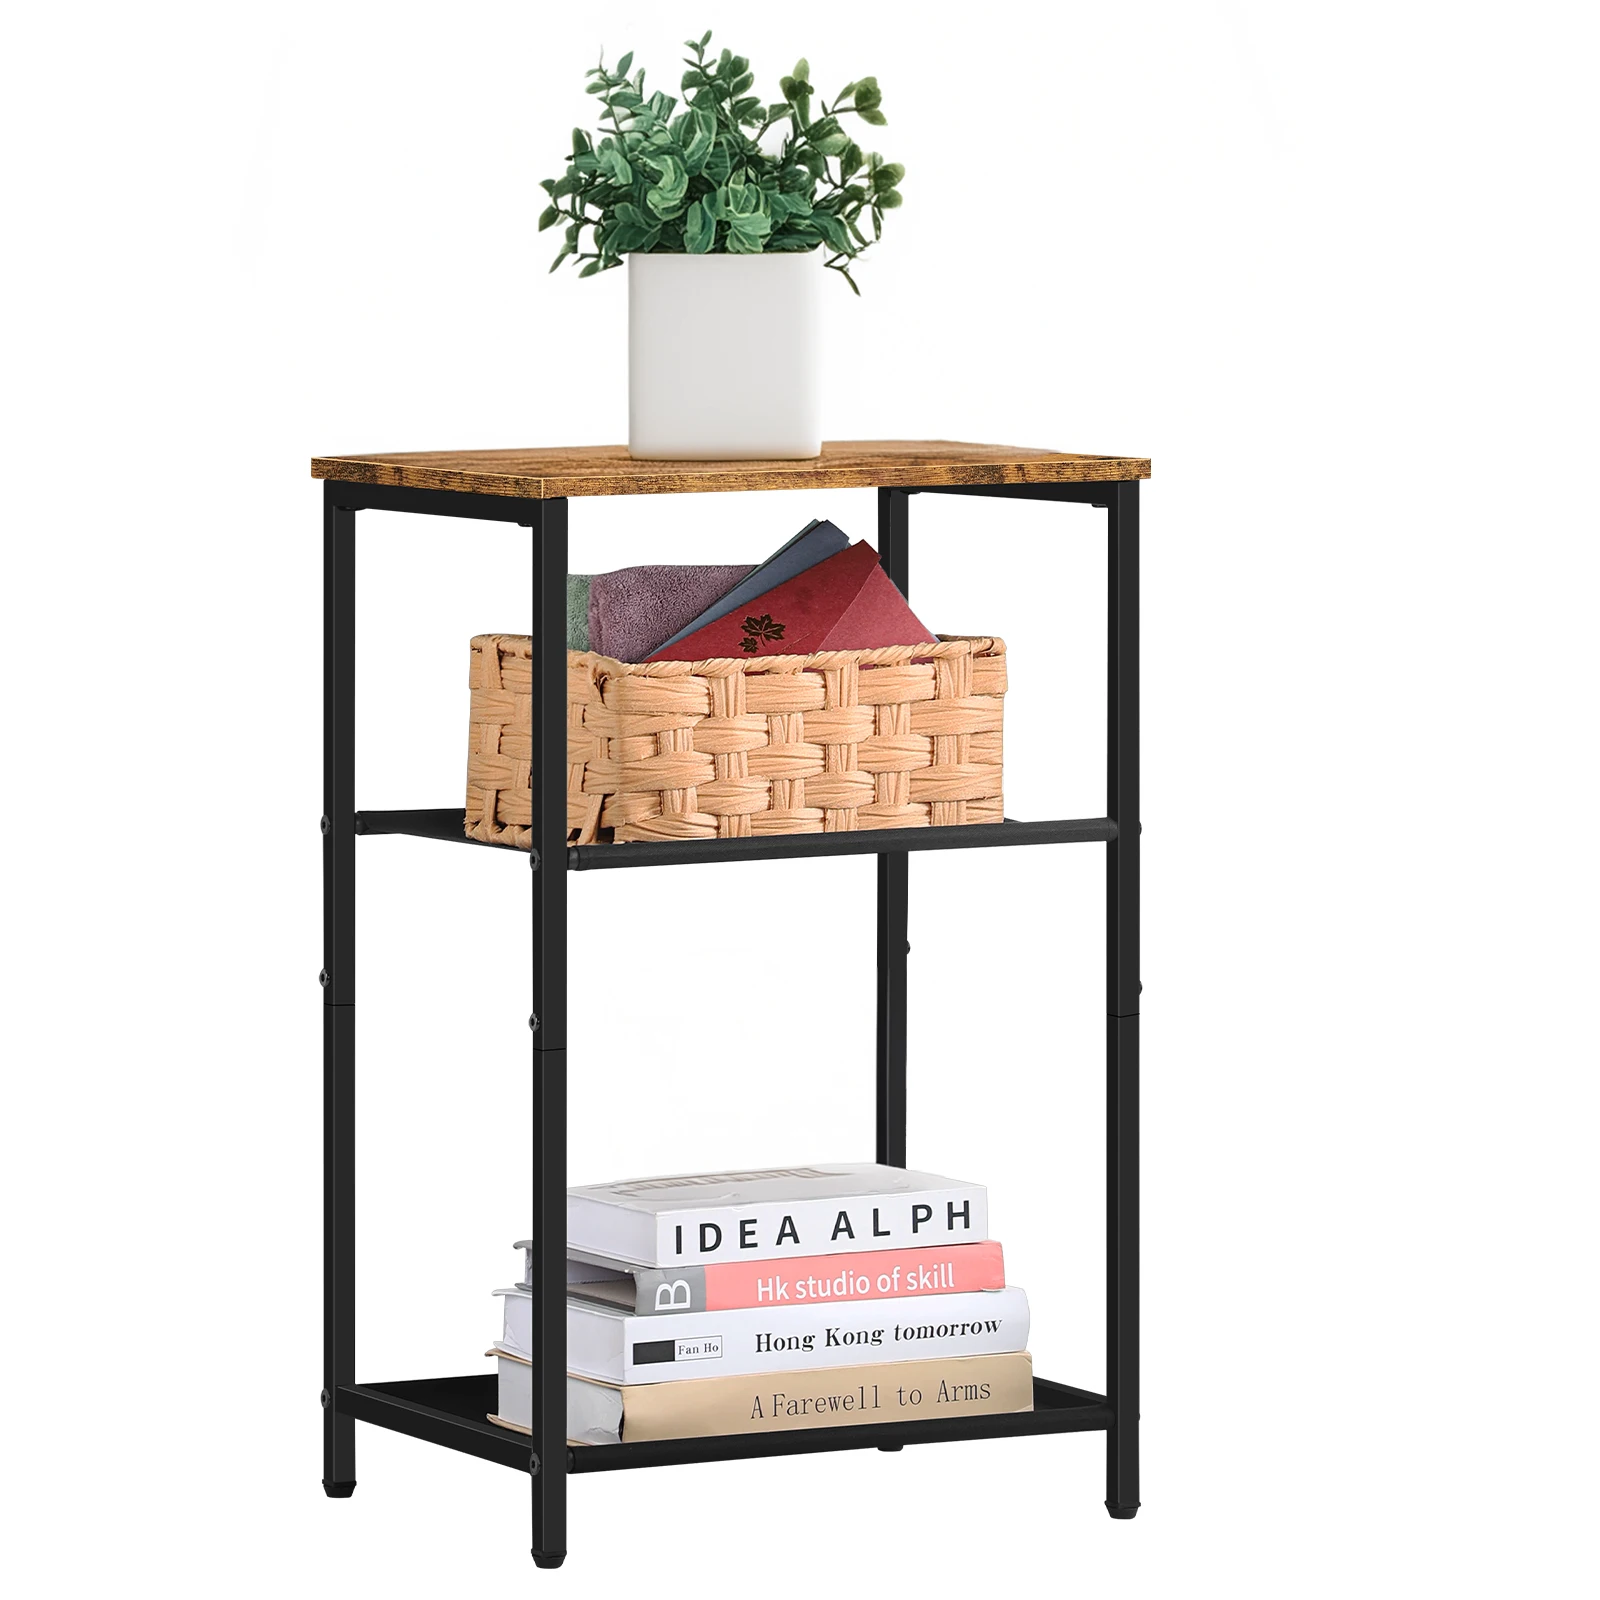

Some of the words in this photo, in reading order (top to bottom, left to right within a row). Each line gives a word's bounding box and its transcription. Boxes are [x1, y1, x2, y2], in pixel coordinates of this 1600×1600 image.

[676, 1215, 800, 1255] IDEA
[830, 1200, 971, 1241] ALPH
[655, 1279, 691, 1310] B
[757, 1276, 790, 1302] Hk
[795, 1270, 872, 1299] studio
[876, 1266, 901, 1293] of
[907, 1262, 955, 1290] skill
[678, 1345, 699, 1356] Fan
[704, 1342, 719, 1353] Ho
[755, 1333, 816, 1353] Hong
[825, 1327, 885, 1347] Kong
[895, 1319, 1002, 1342] tomorrow
[751, 1395, 764, 1420] A
[773, 1385, 881, 1417] Farewell
[897, 1387, 922, 1407] to
[936, 1379, 991, 1403] Arms
